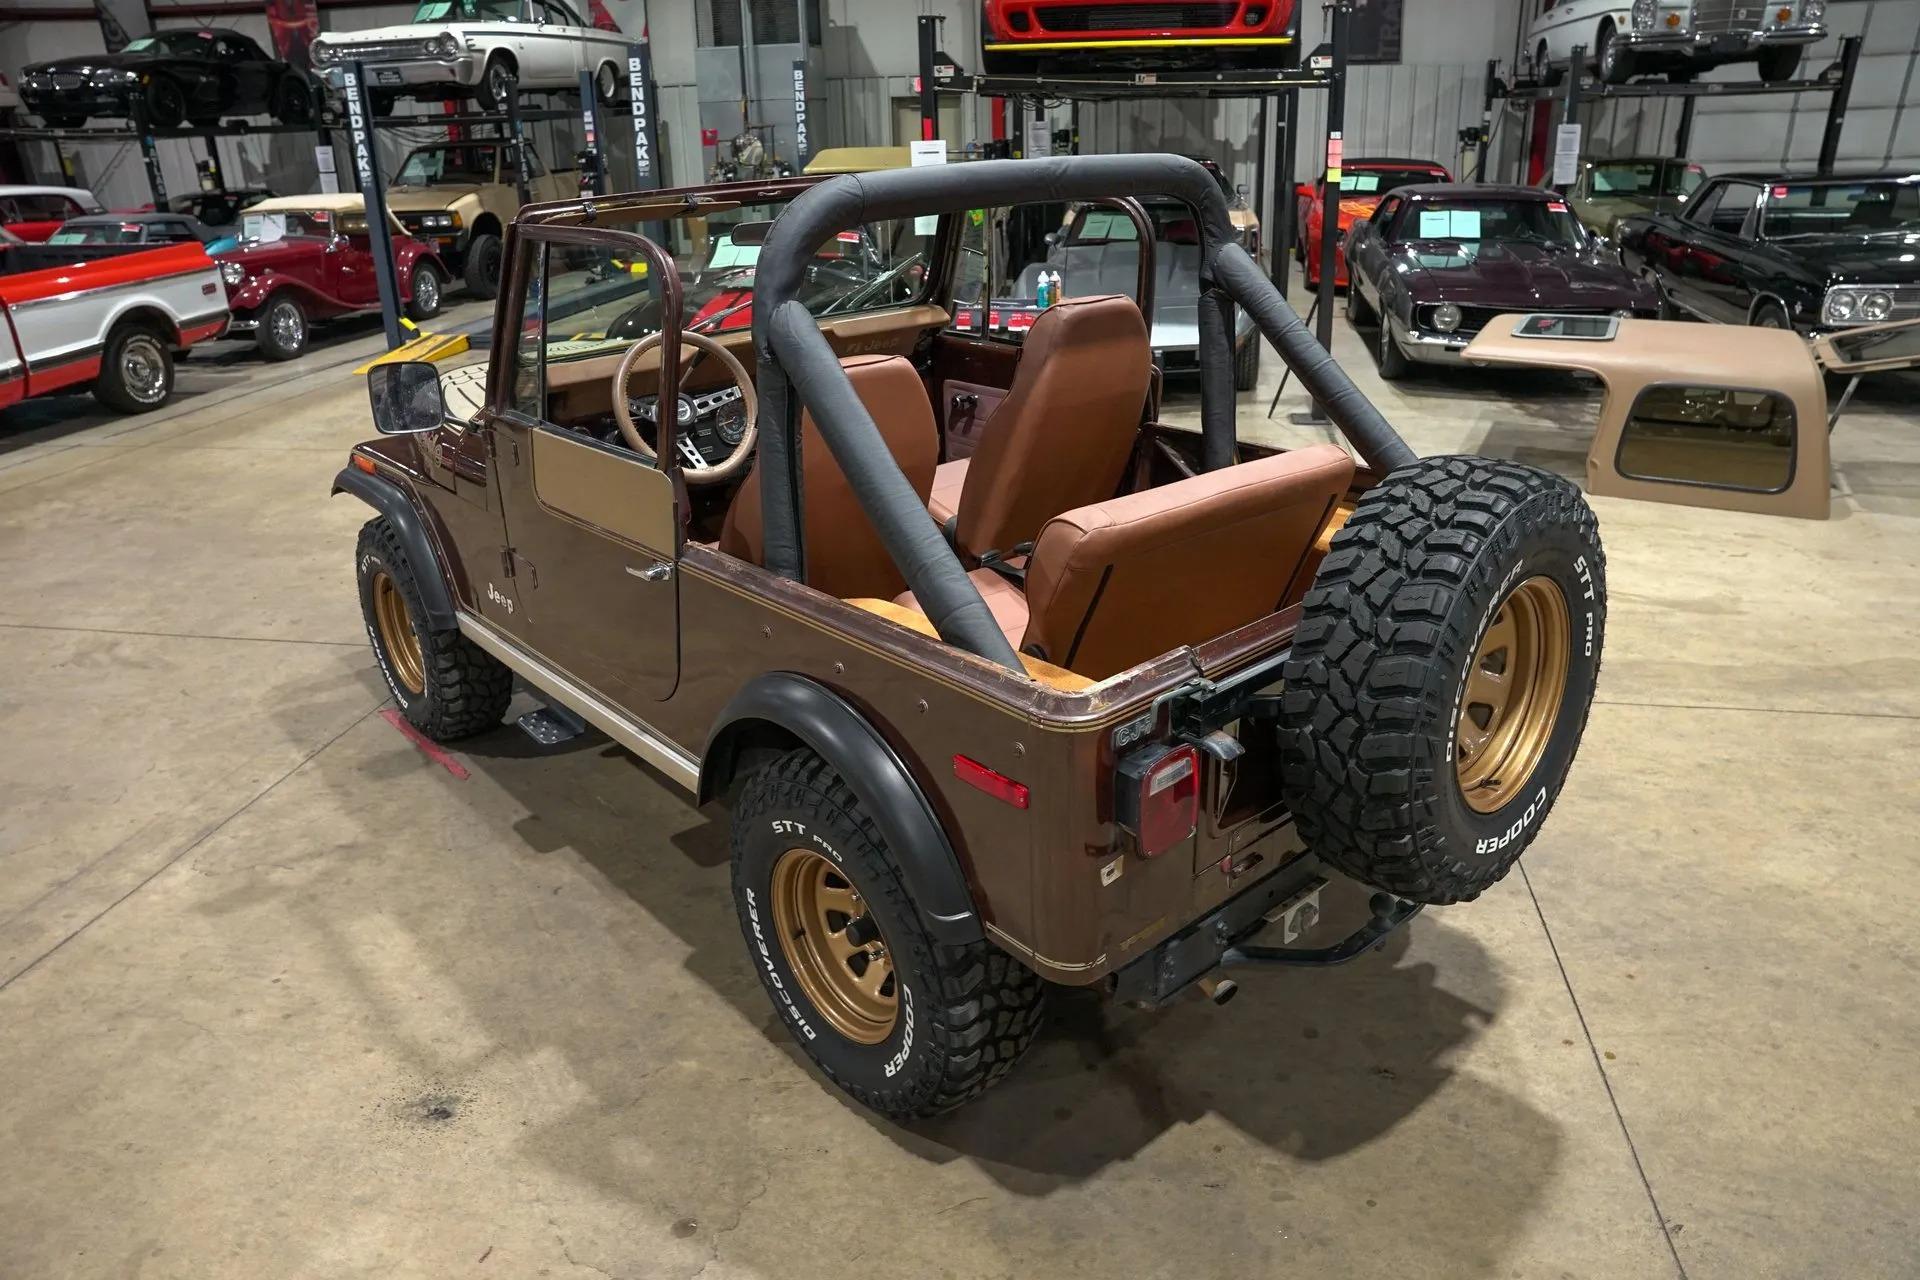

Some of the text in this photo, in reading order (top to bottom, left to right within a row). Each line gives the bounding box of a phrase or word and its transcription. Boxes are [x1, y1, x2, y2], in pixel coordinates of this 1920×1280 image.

[343, 72, 371, 171] BENDPAK
[628, 57, 650, 160] BENDPAK
[793, 69, 807, 144] BENDPAK
[361, 554, 371, 574] STT
[487, 582, 514, 615] Jeep
[1573, 555, 1595, 657] STT PRO
[771, 819, 843, 863] STT PRO
[1475, 786, 1547, 855] COOPER
[745, 887, 817, 1041] DISCOVERER
[884, 983, 915, 1078] COOPER
